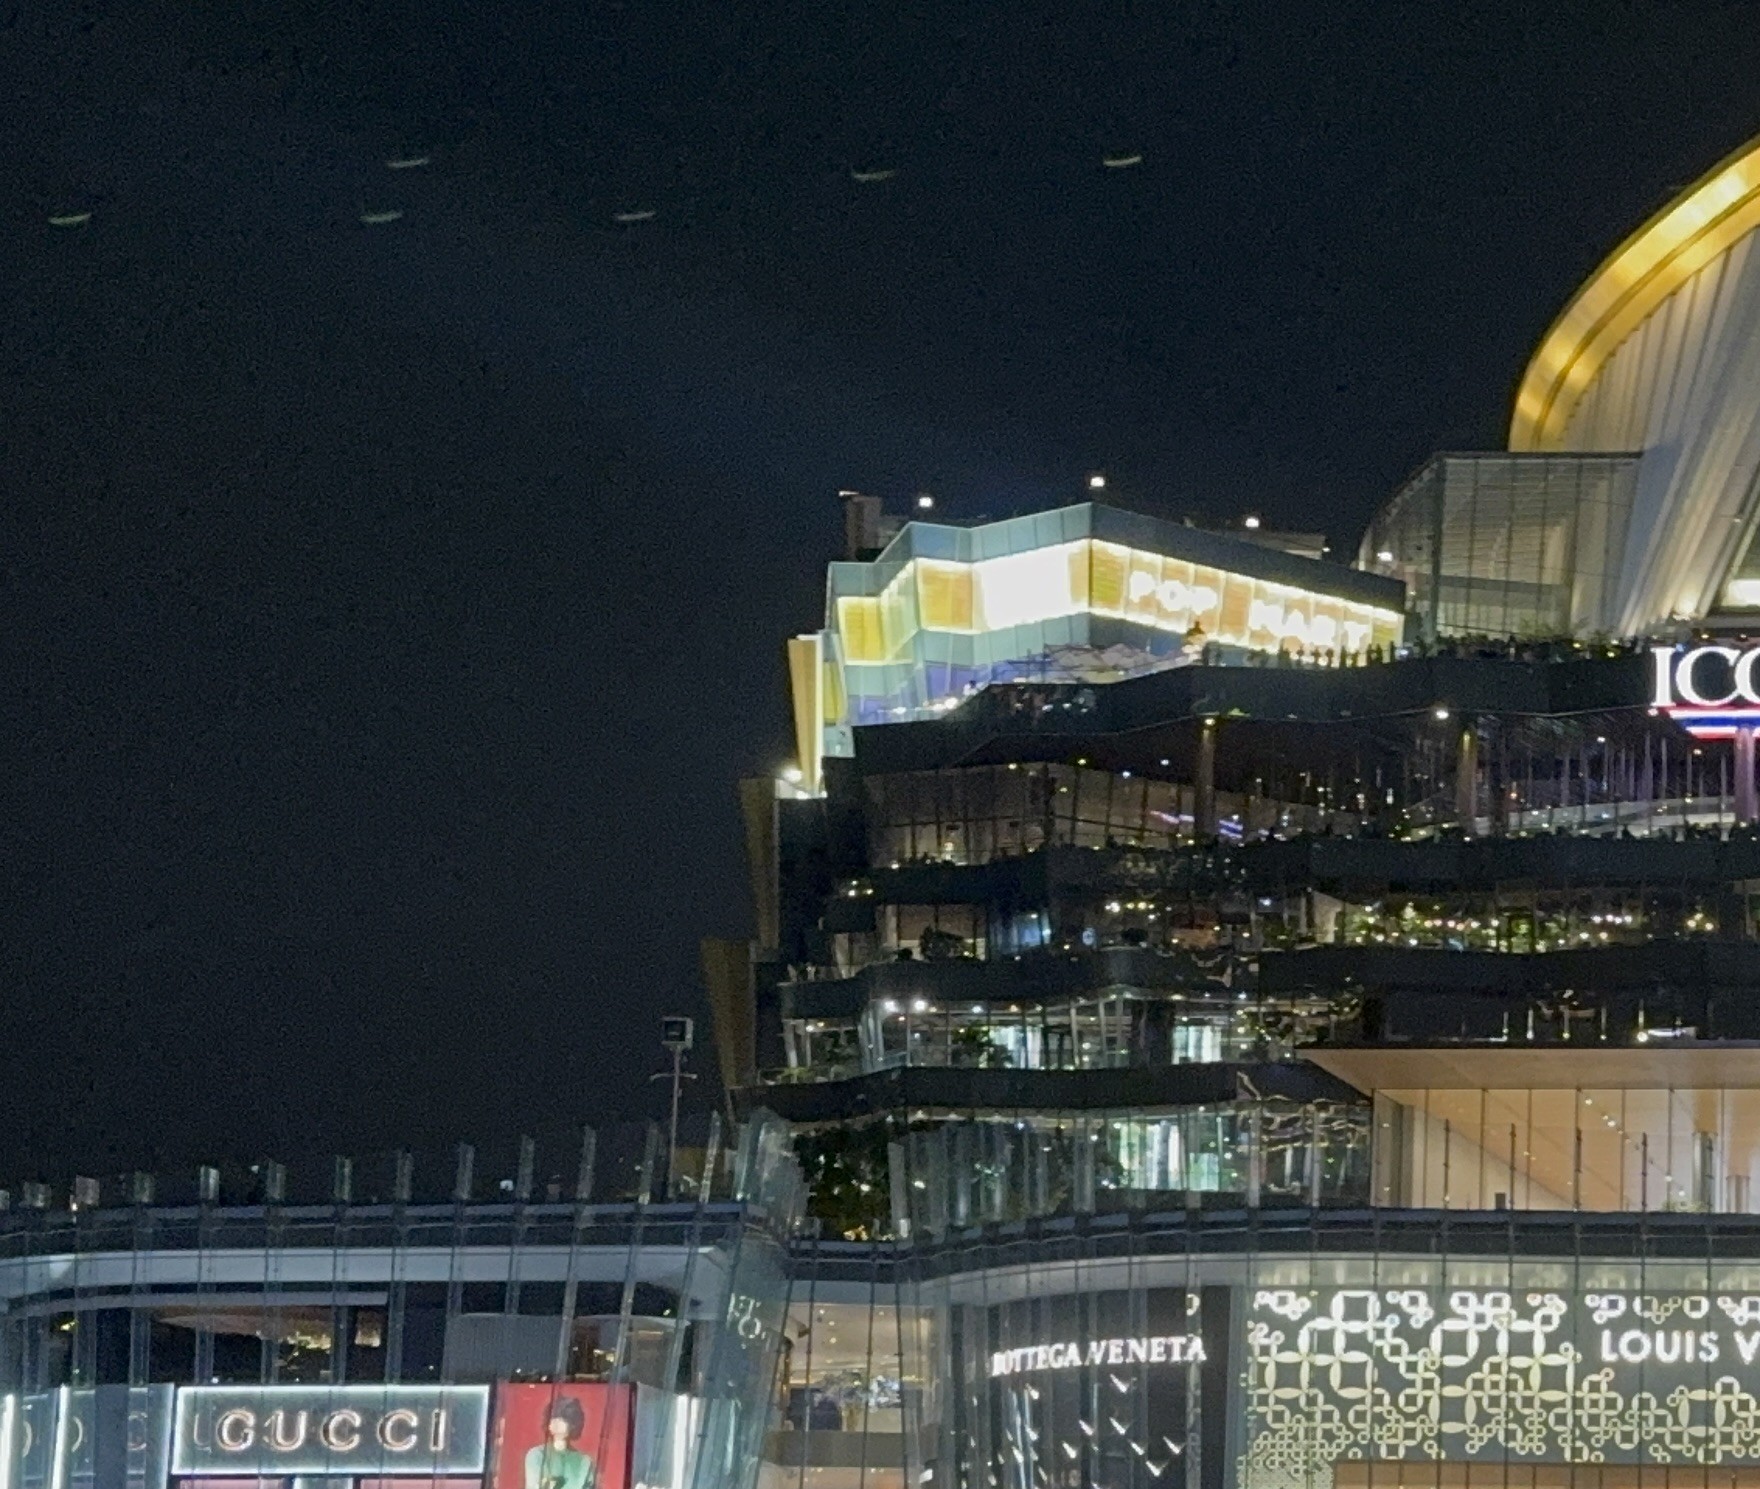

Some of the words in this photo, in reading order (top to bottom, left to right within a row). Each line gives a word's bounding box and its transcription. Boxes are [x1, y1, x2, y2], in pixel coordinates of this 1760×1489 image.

[989, 1342, 1082, 1377] BOTTEGA
[1084, 1334, 1207, 1366] VENETA
[1600, 1329, 1720, 1364] LOUIS
[215, 1408, 447, 1452] GUCCI
